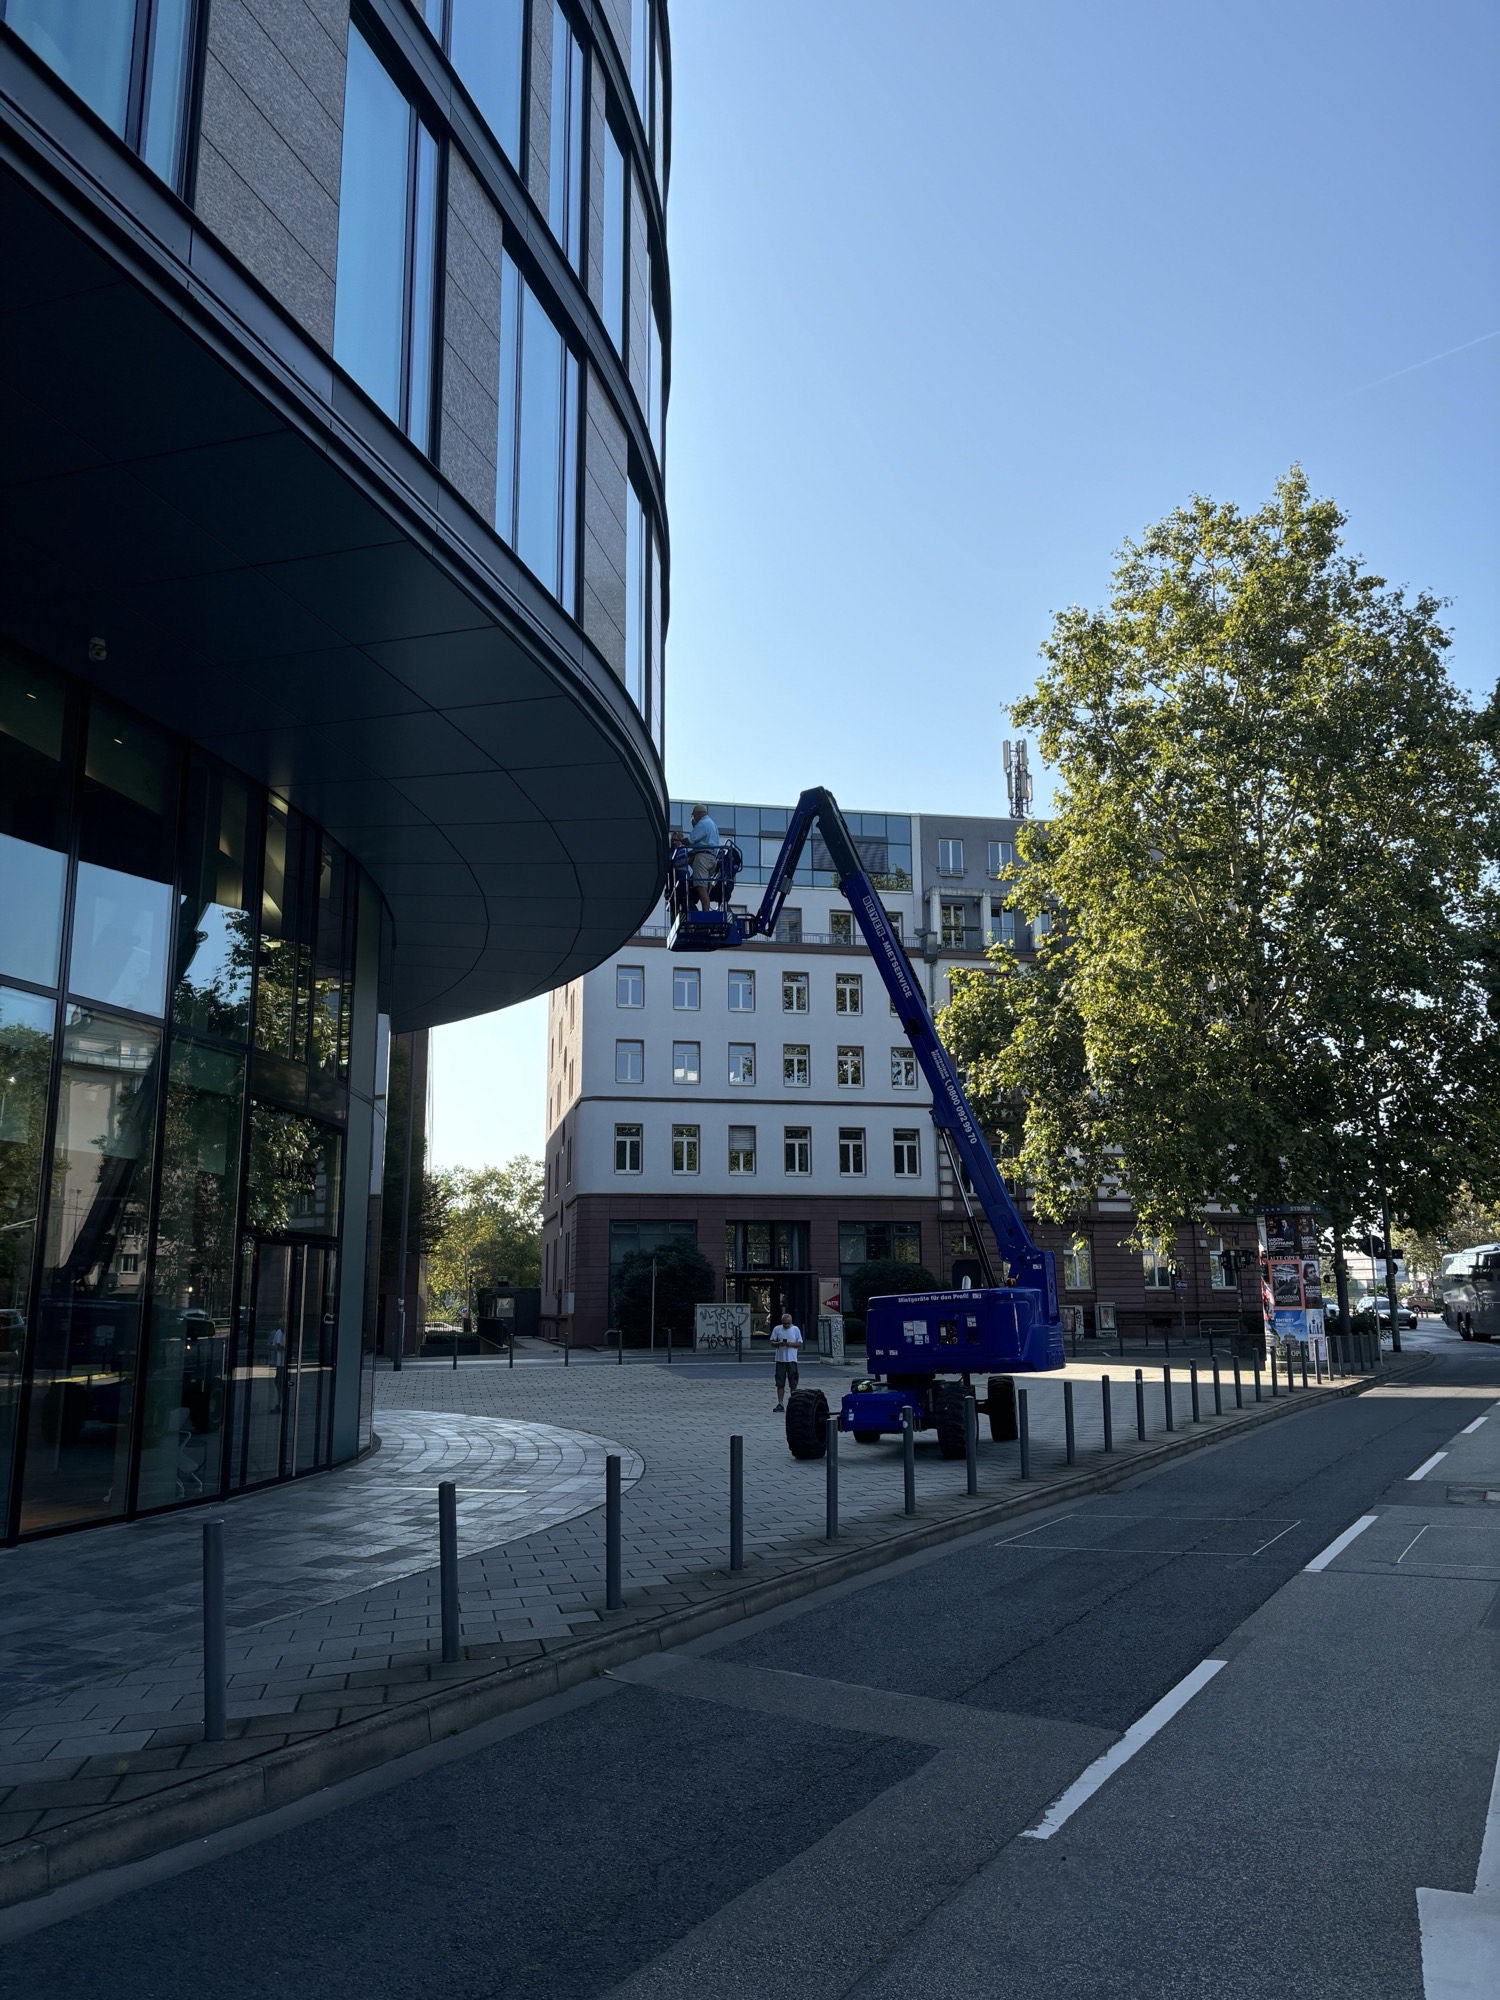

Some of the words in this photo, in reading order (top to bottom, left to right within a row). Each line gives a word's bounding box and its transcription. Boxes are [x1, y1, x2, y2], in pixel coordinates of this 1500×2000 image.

[947, 1085, 961, 1106] 0800
[956, 1105, 968, 1123] 092
[963, 1121, 973, 1133] 99
[968, 1132, 978, 1144] 70
